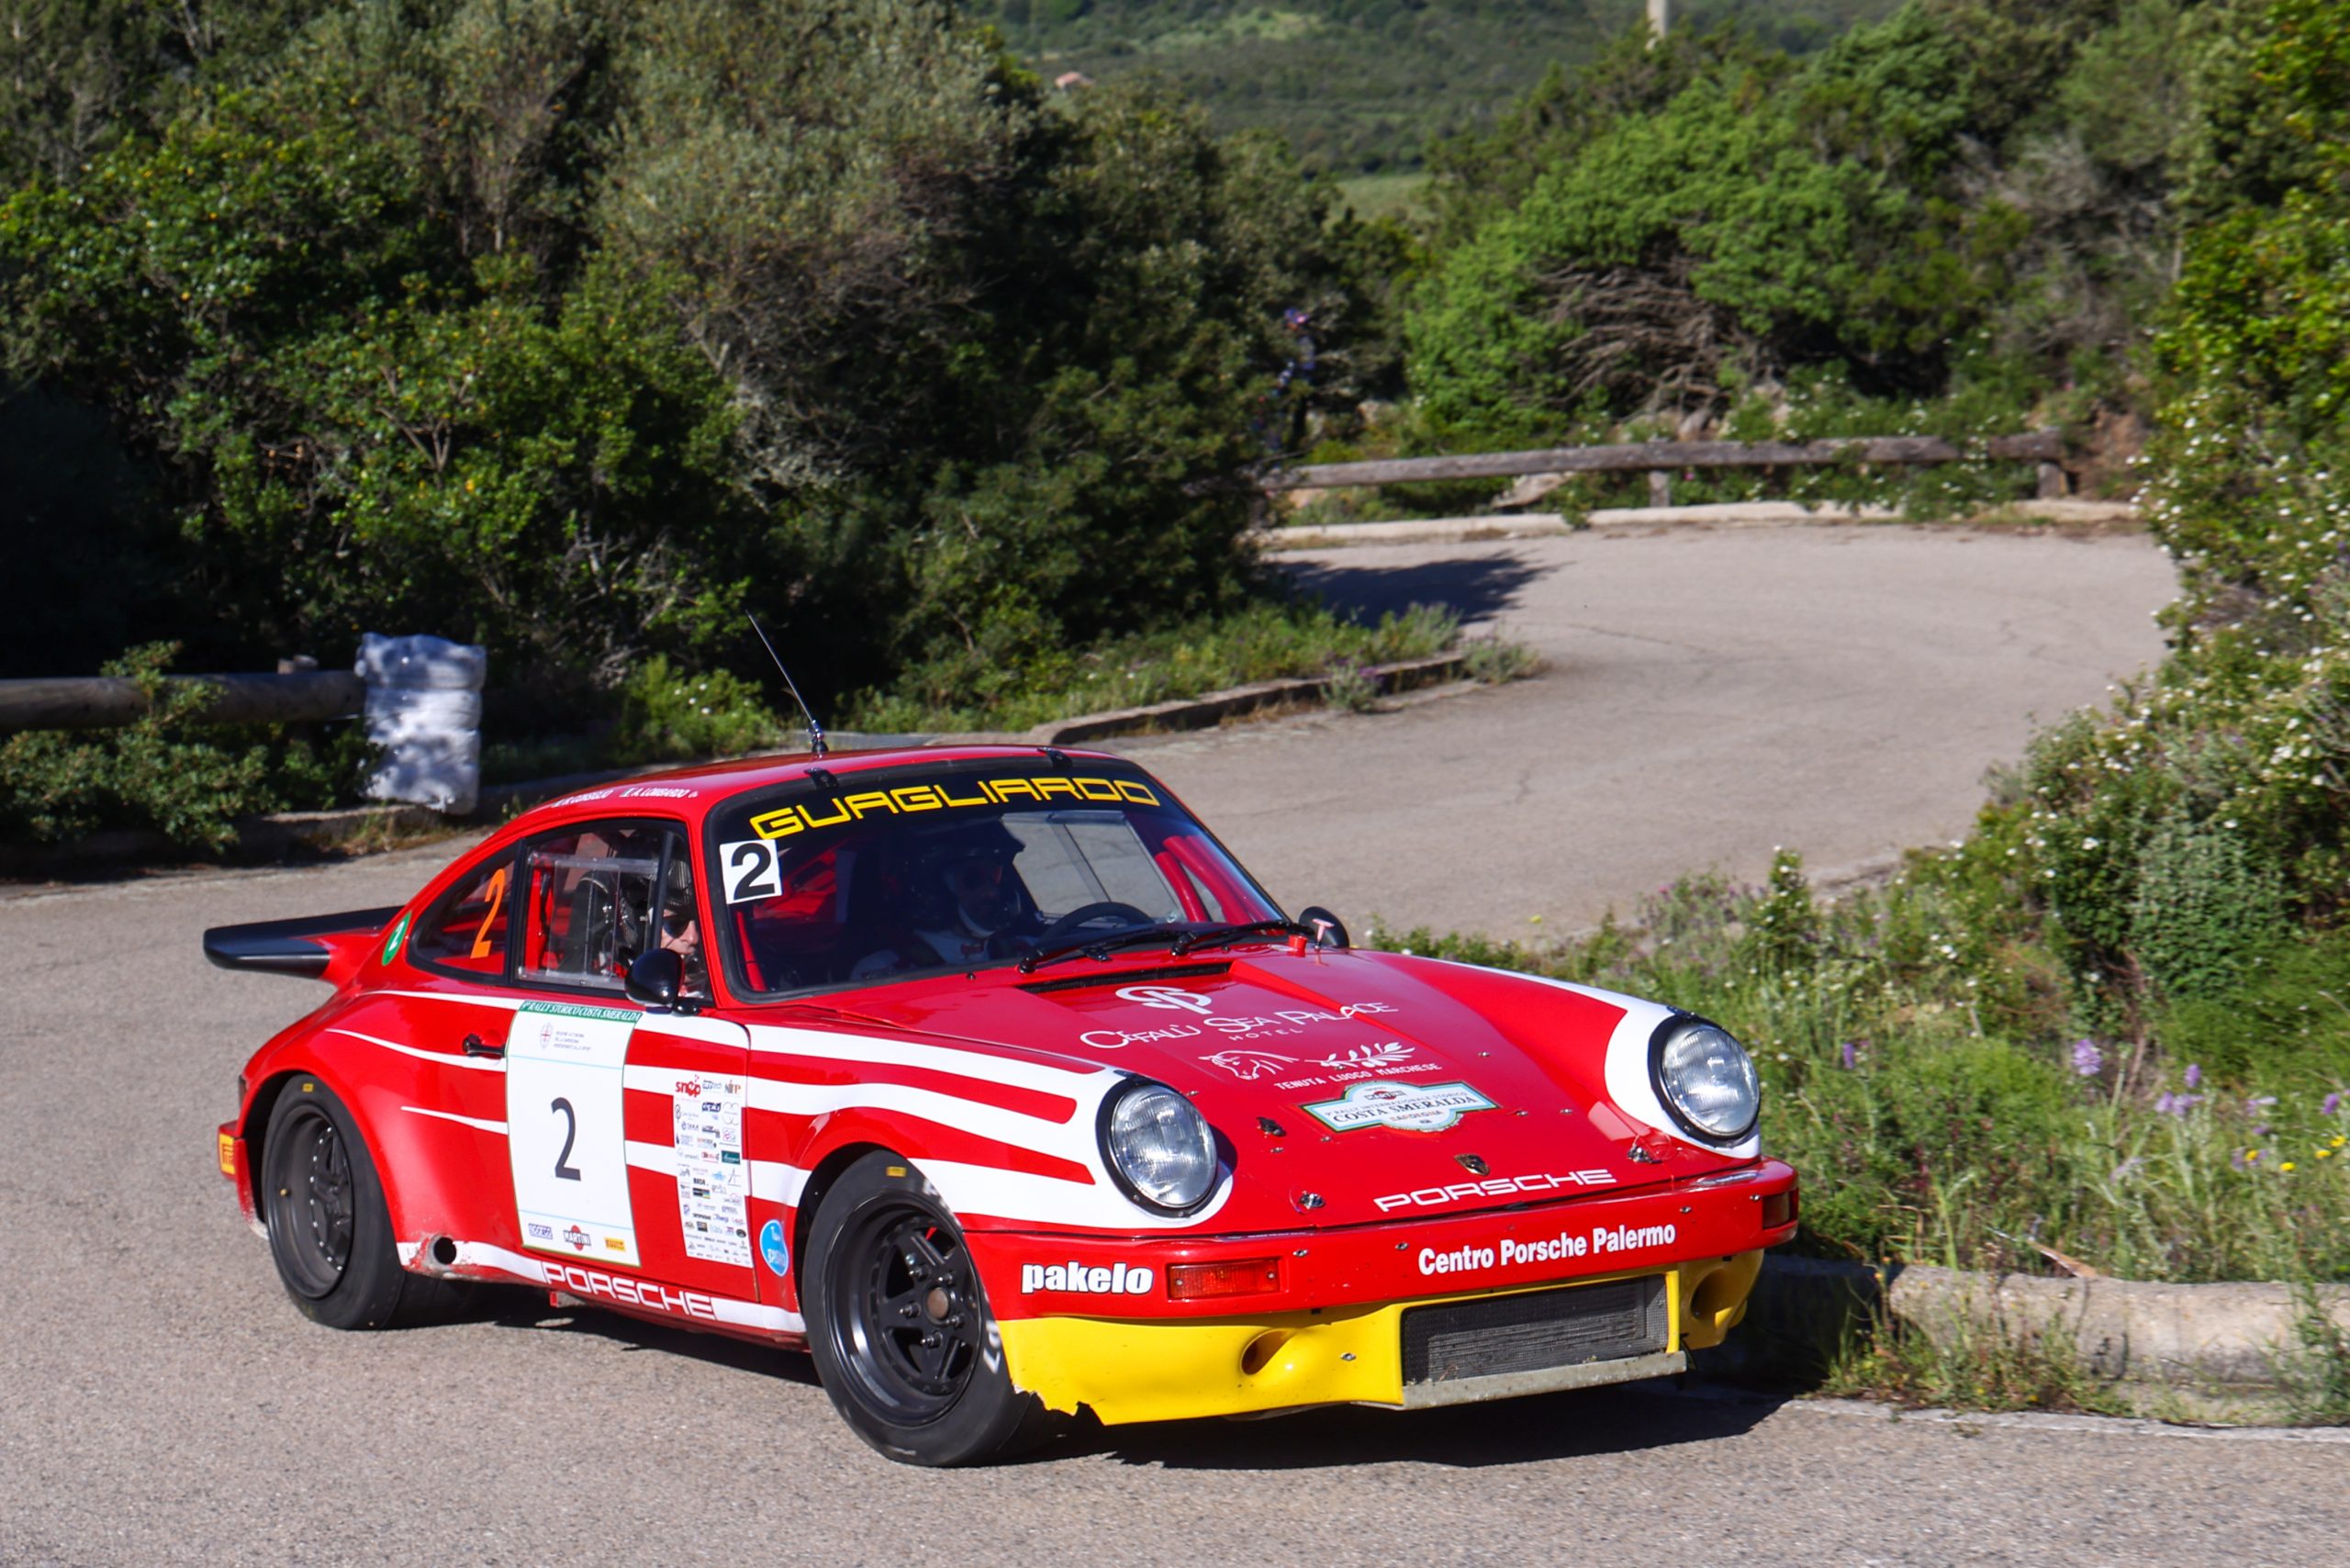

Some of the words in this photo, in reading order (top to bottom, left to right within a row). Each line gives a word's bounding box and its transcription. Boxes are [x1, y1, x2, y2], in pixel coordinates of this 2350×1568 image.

[749, 778, 1160, 840] GUAGLIARDO
[731, 843, 776, 900] 2
[470, 868, 505, 958] 2
[1203, 1016, 1281, 1033] SEA
[1274, 1002, 1399, 1025] PALACE
[1228, 1027, 1304, 1042] HOTEL
[1274, 1077, 1327, 1091] TENUTA
[1375, 1062, 1442, 1076] MARCHESE
[1333, 1109, 1387, 1123] COSTA
[1389, 1096, 1477, 1113] SMERALDA
[1390, 1110, 1442, 1121] SARDEGNA
[551, 1097, 581, 1182] 2
[1373, 1169, 1617, 1213] PORSCHE
[1418, 1246, 1494, 1276] Centro
[1500, 1232, 1587, 1266] Porsche
[1592, 1224, 1676, 1254] Palermo
[543, 1261, 717, 1320] PORSCHE
[1021, 1261, 1154, 1294] pakelo
